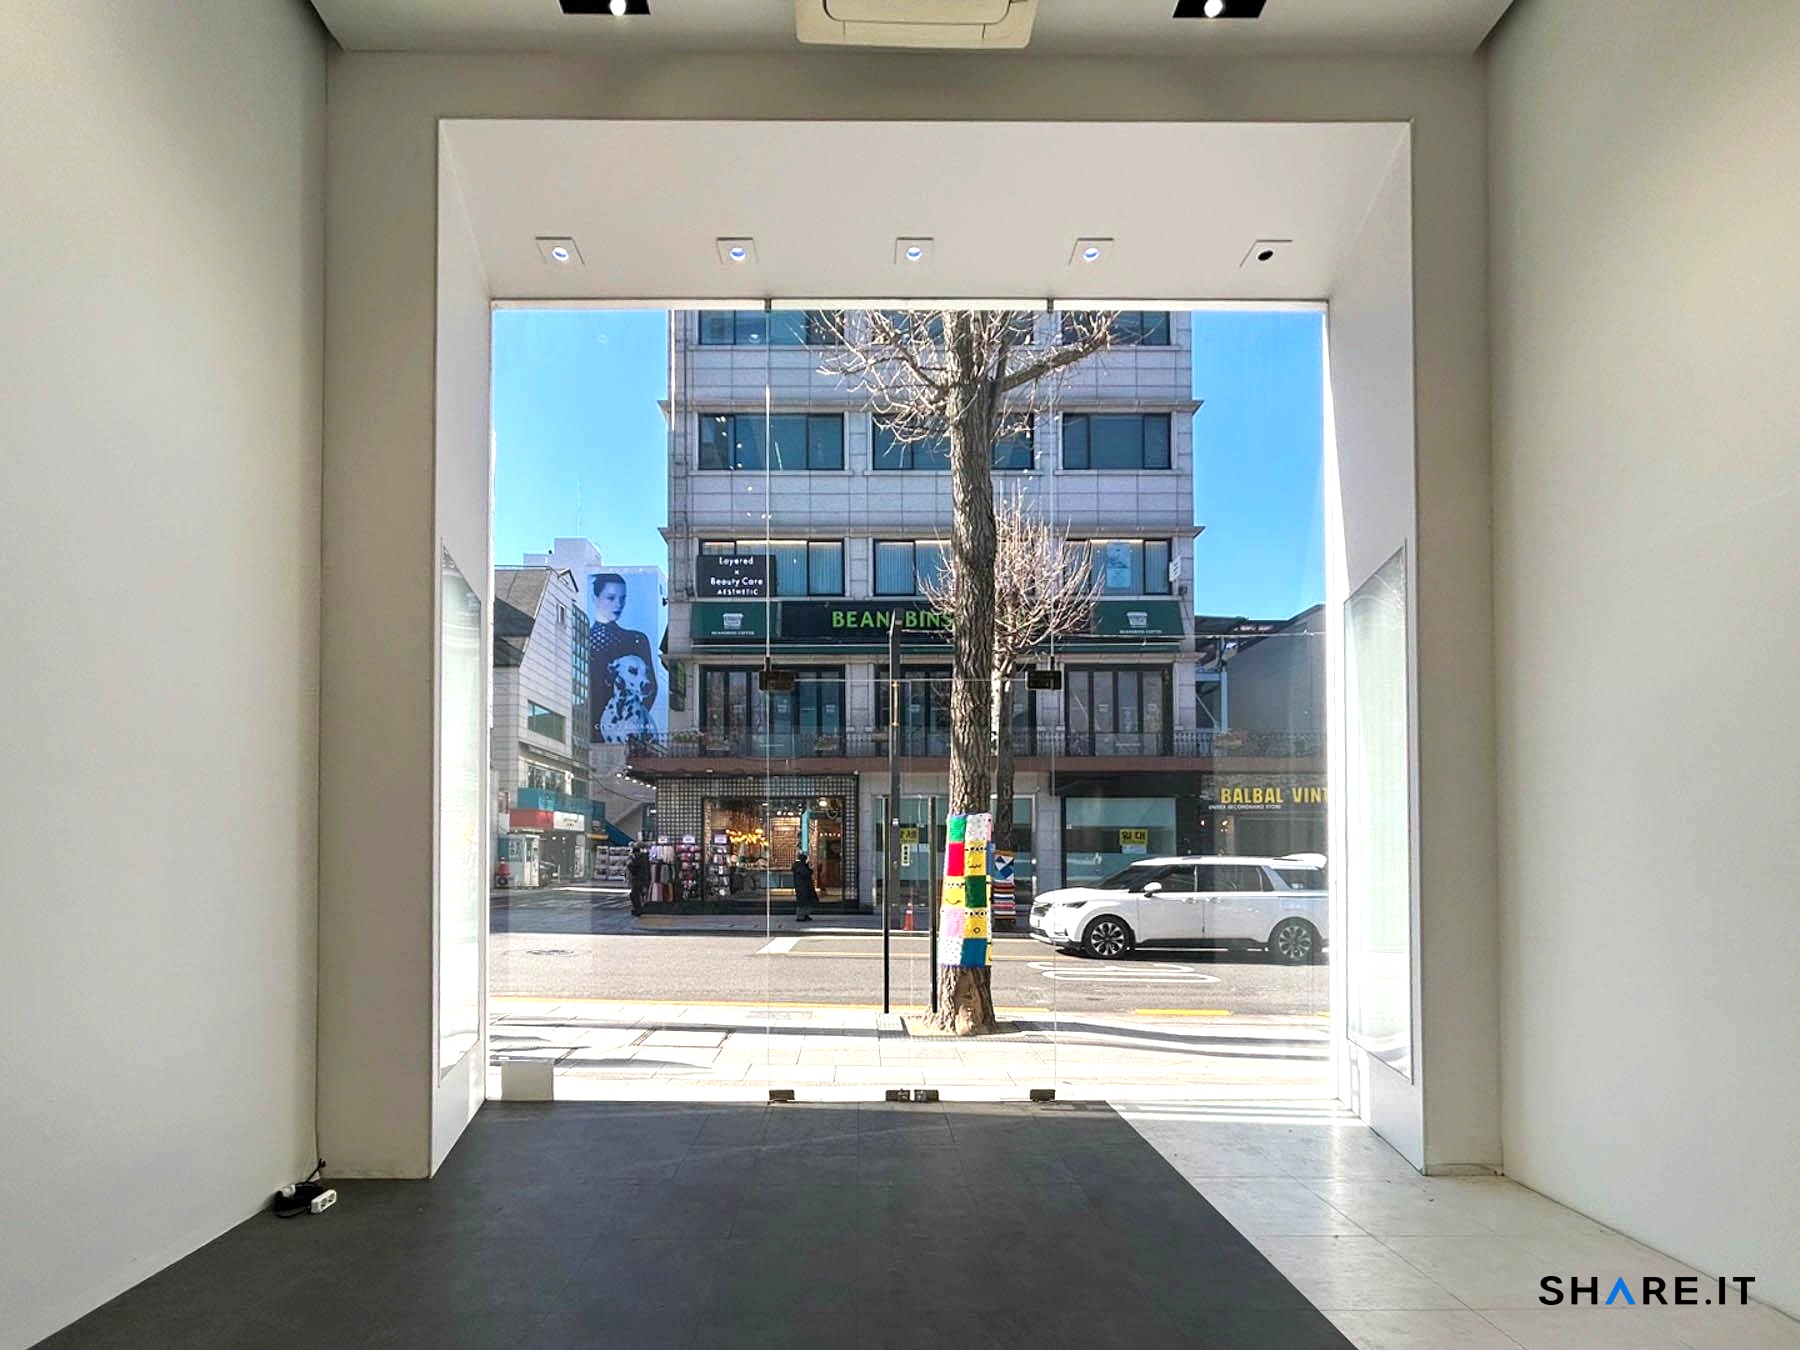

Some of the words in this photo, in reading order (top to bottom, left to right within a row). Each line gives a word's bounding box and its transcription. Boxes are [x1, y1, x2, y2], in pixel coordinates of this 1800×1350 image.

[719, 556, 754, 567] Layered
[710, 576, 740, 587] Beauty
[741, 576, 763, 586] Care
[717, 588, 759, 596] AESTHETIC
[1221, 787, 1284, 804] BALBAL
